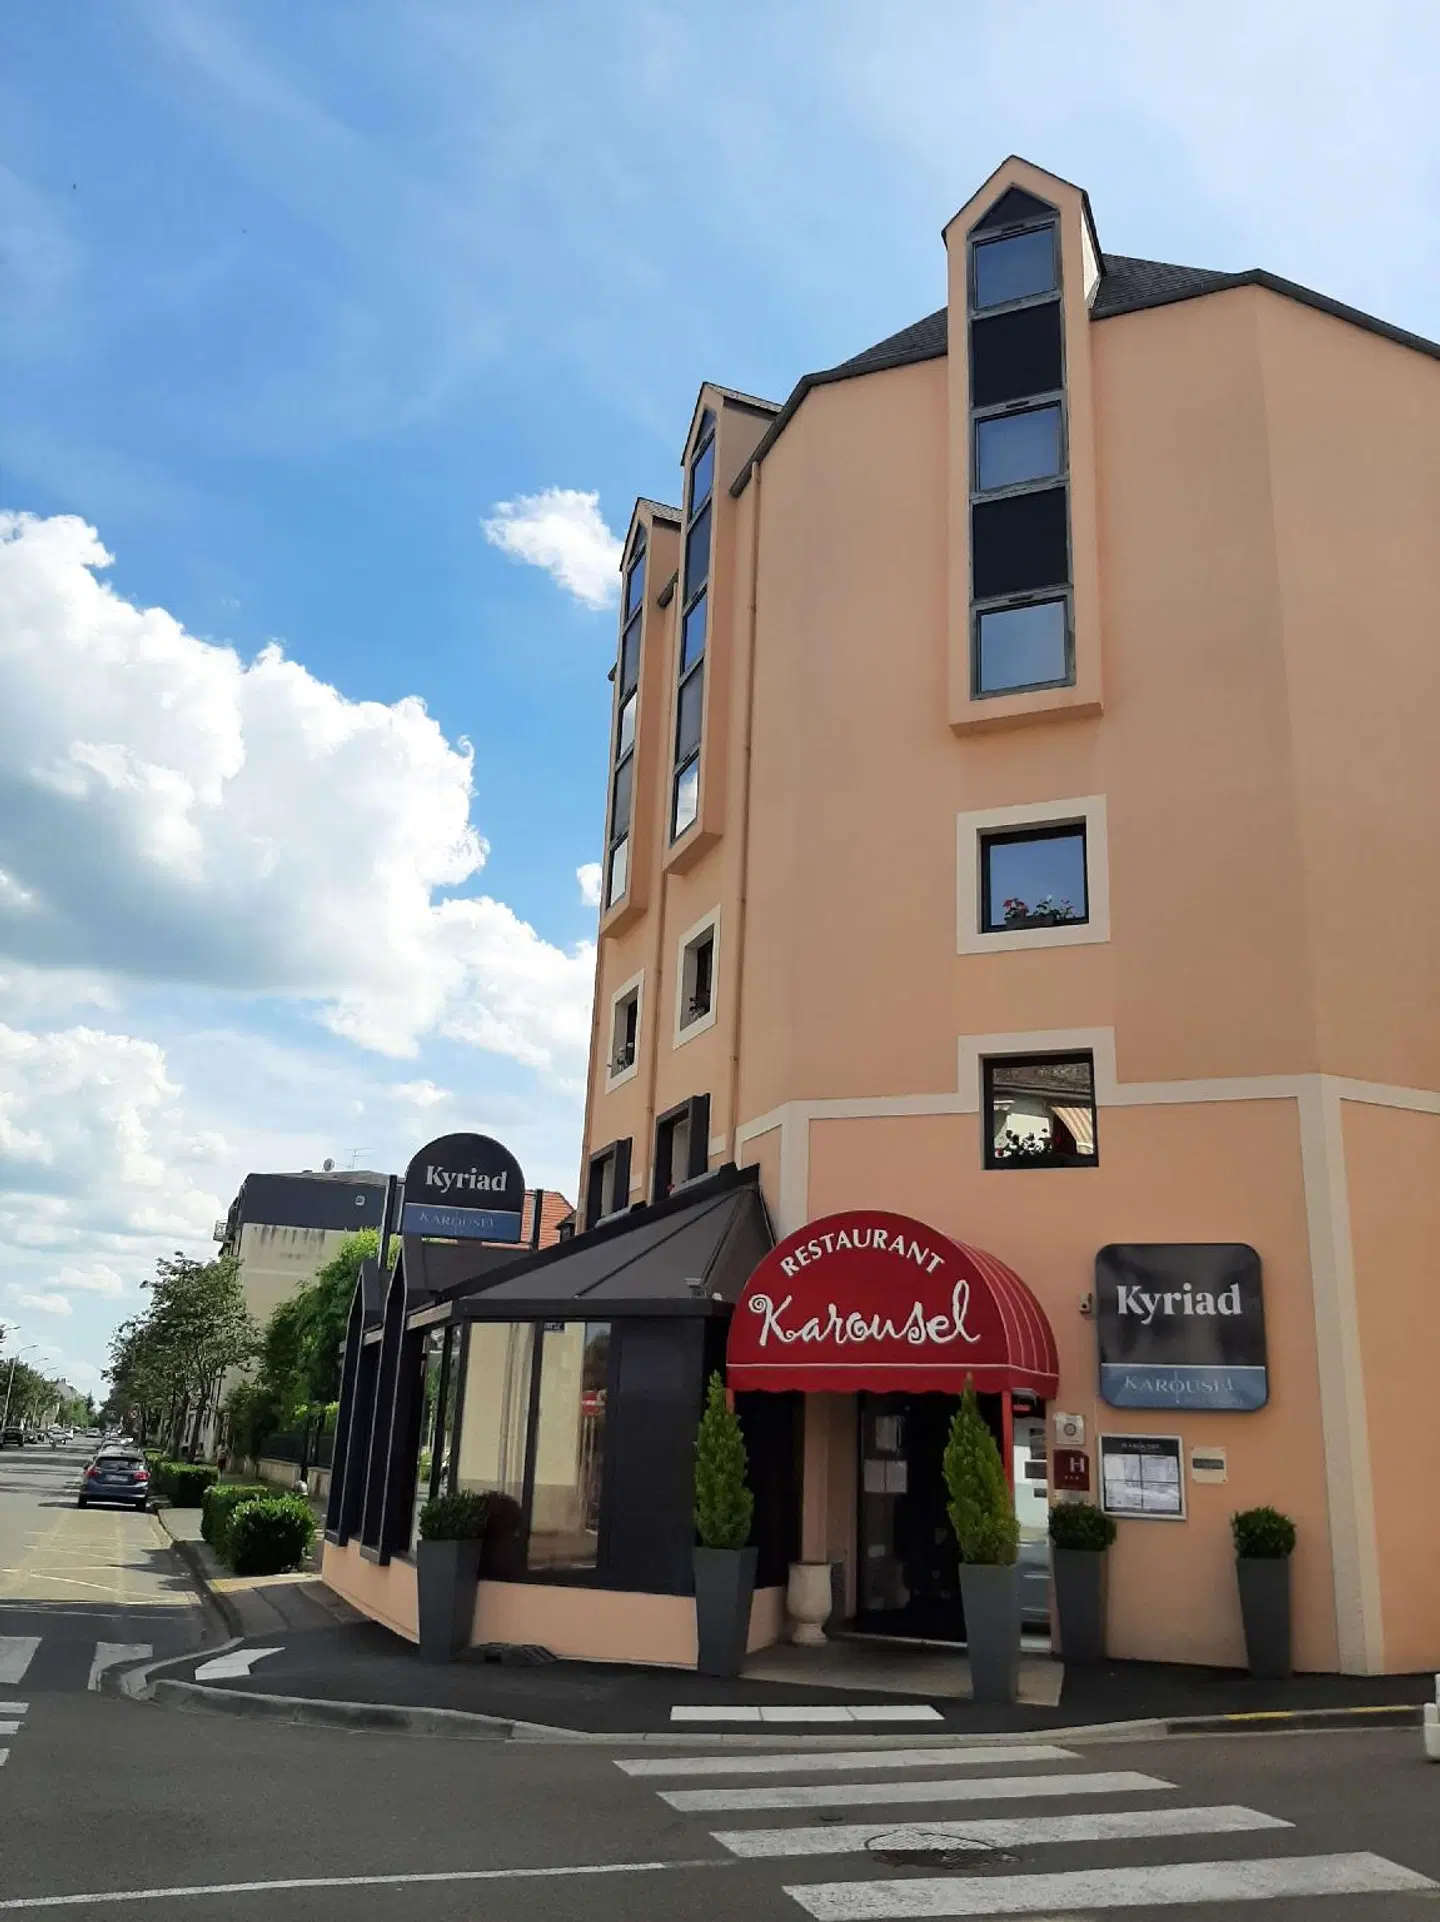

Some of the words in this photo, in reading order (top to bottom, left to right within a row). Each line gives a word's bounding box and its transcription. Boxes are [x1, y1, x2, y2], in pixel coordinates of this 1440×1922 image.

[426, 1165, 507, 1193] Kyriad
[780, 1228, 944, 1277] RESTAURANT
[749, 1279, 981, 1346] Karousel
[1116, 1282, 1243, 1325] Kyriad
[1070, 1456, 1085, 1473] H
